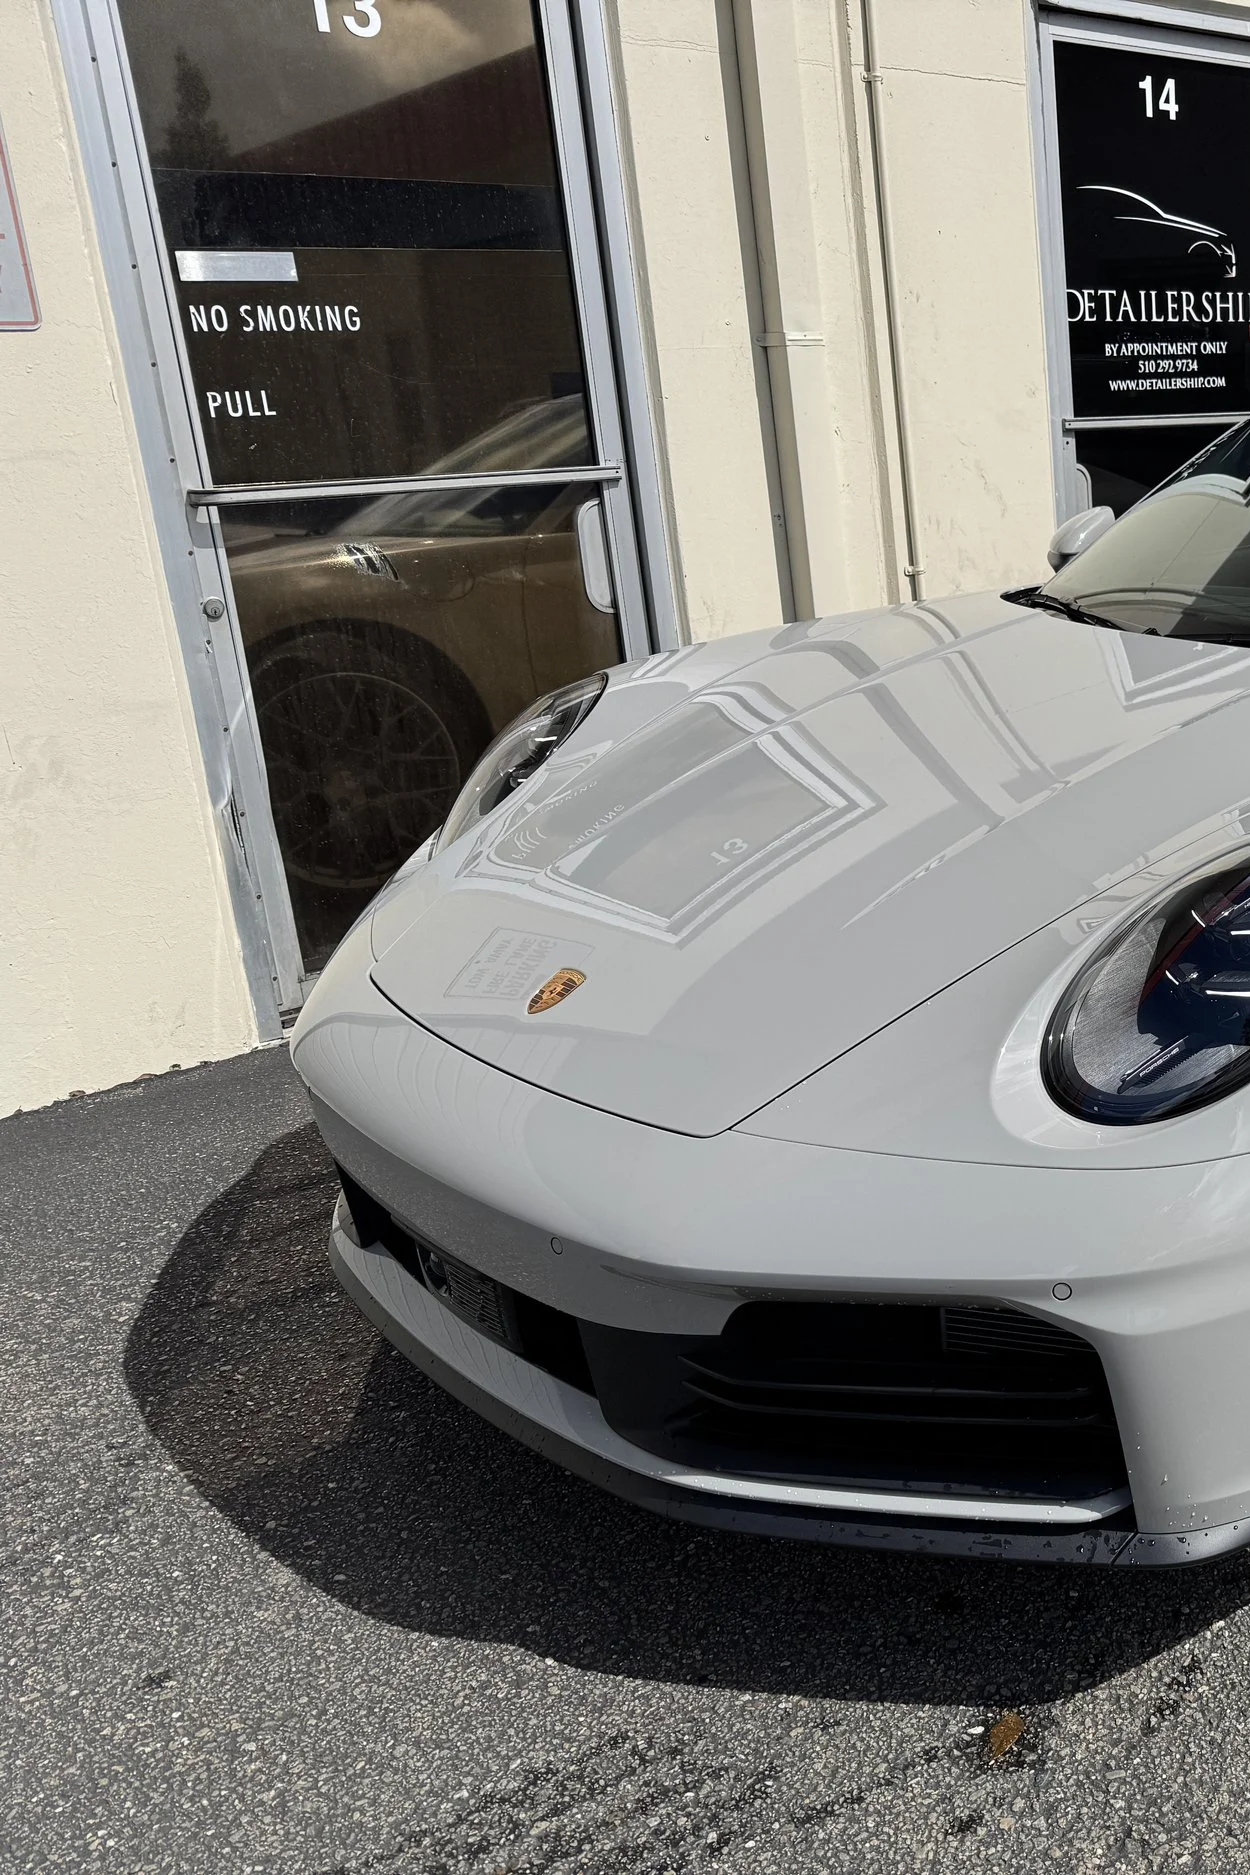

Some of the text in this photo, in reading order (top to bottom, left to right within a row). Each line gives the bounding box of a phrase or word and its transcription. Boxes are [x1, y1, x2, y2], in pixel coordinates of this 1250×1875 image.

[314, 0, 381, 38] 13
[1139, 75, 1179, 121] 14
[189, 304, 361, 332] NO SMOKING
[1105, 341, 1228, 356] BY APPOINTMENT ONLY
[1138, 358, 1198, 373] 510 292 9734
[1109, 376, 1227, 391] WWW.DETAILERSHIP.COM
[207, 389, 277, 418] PULL
